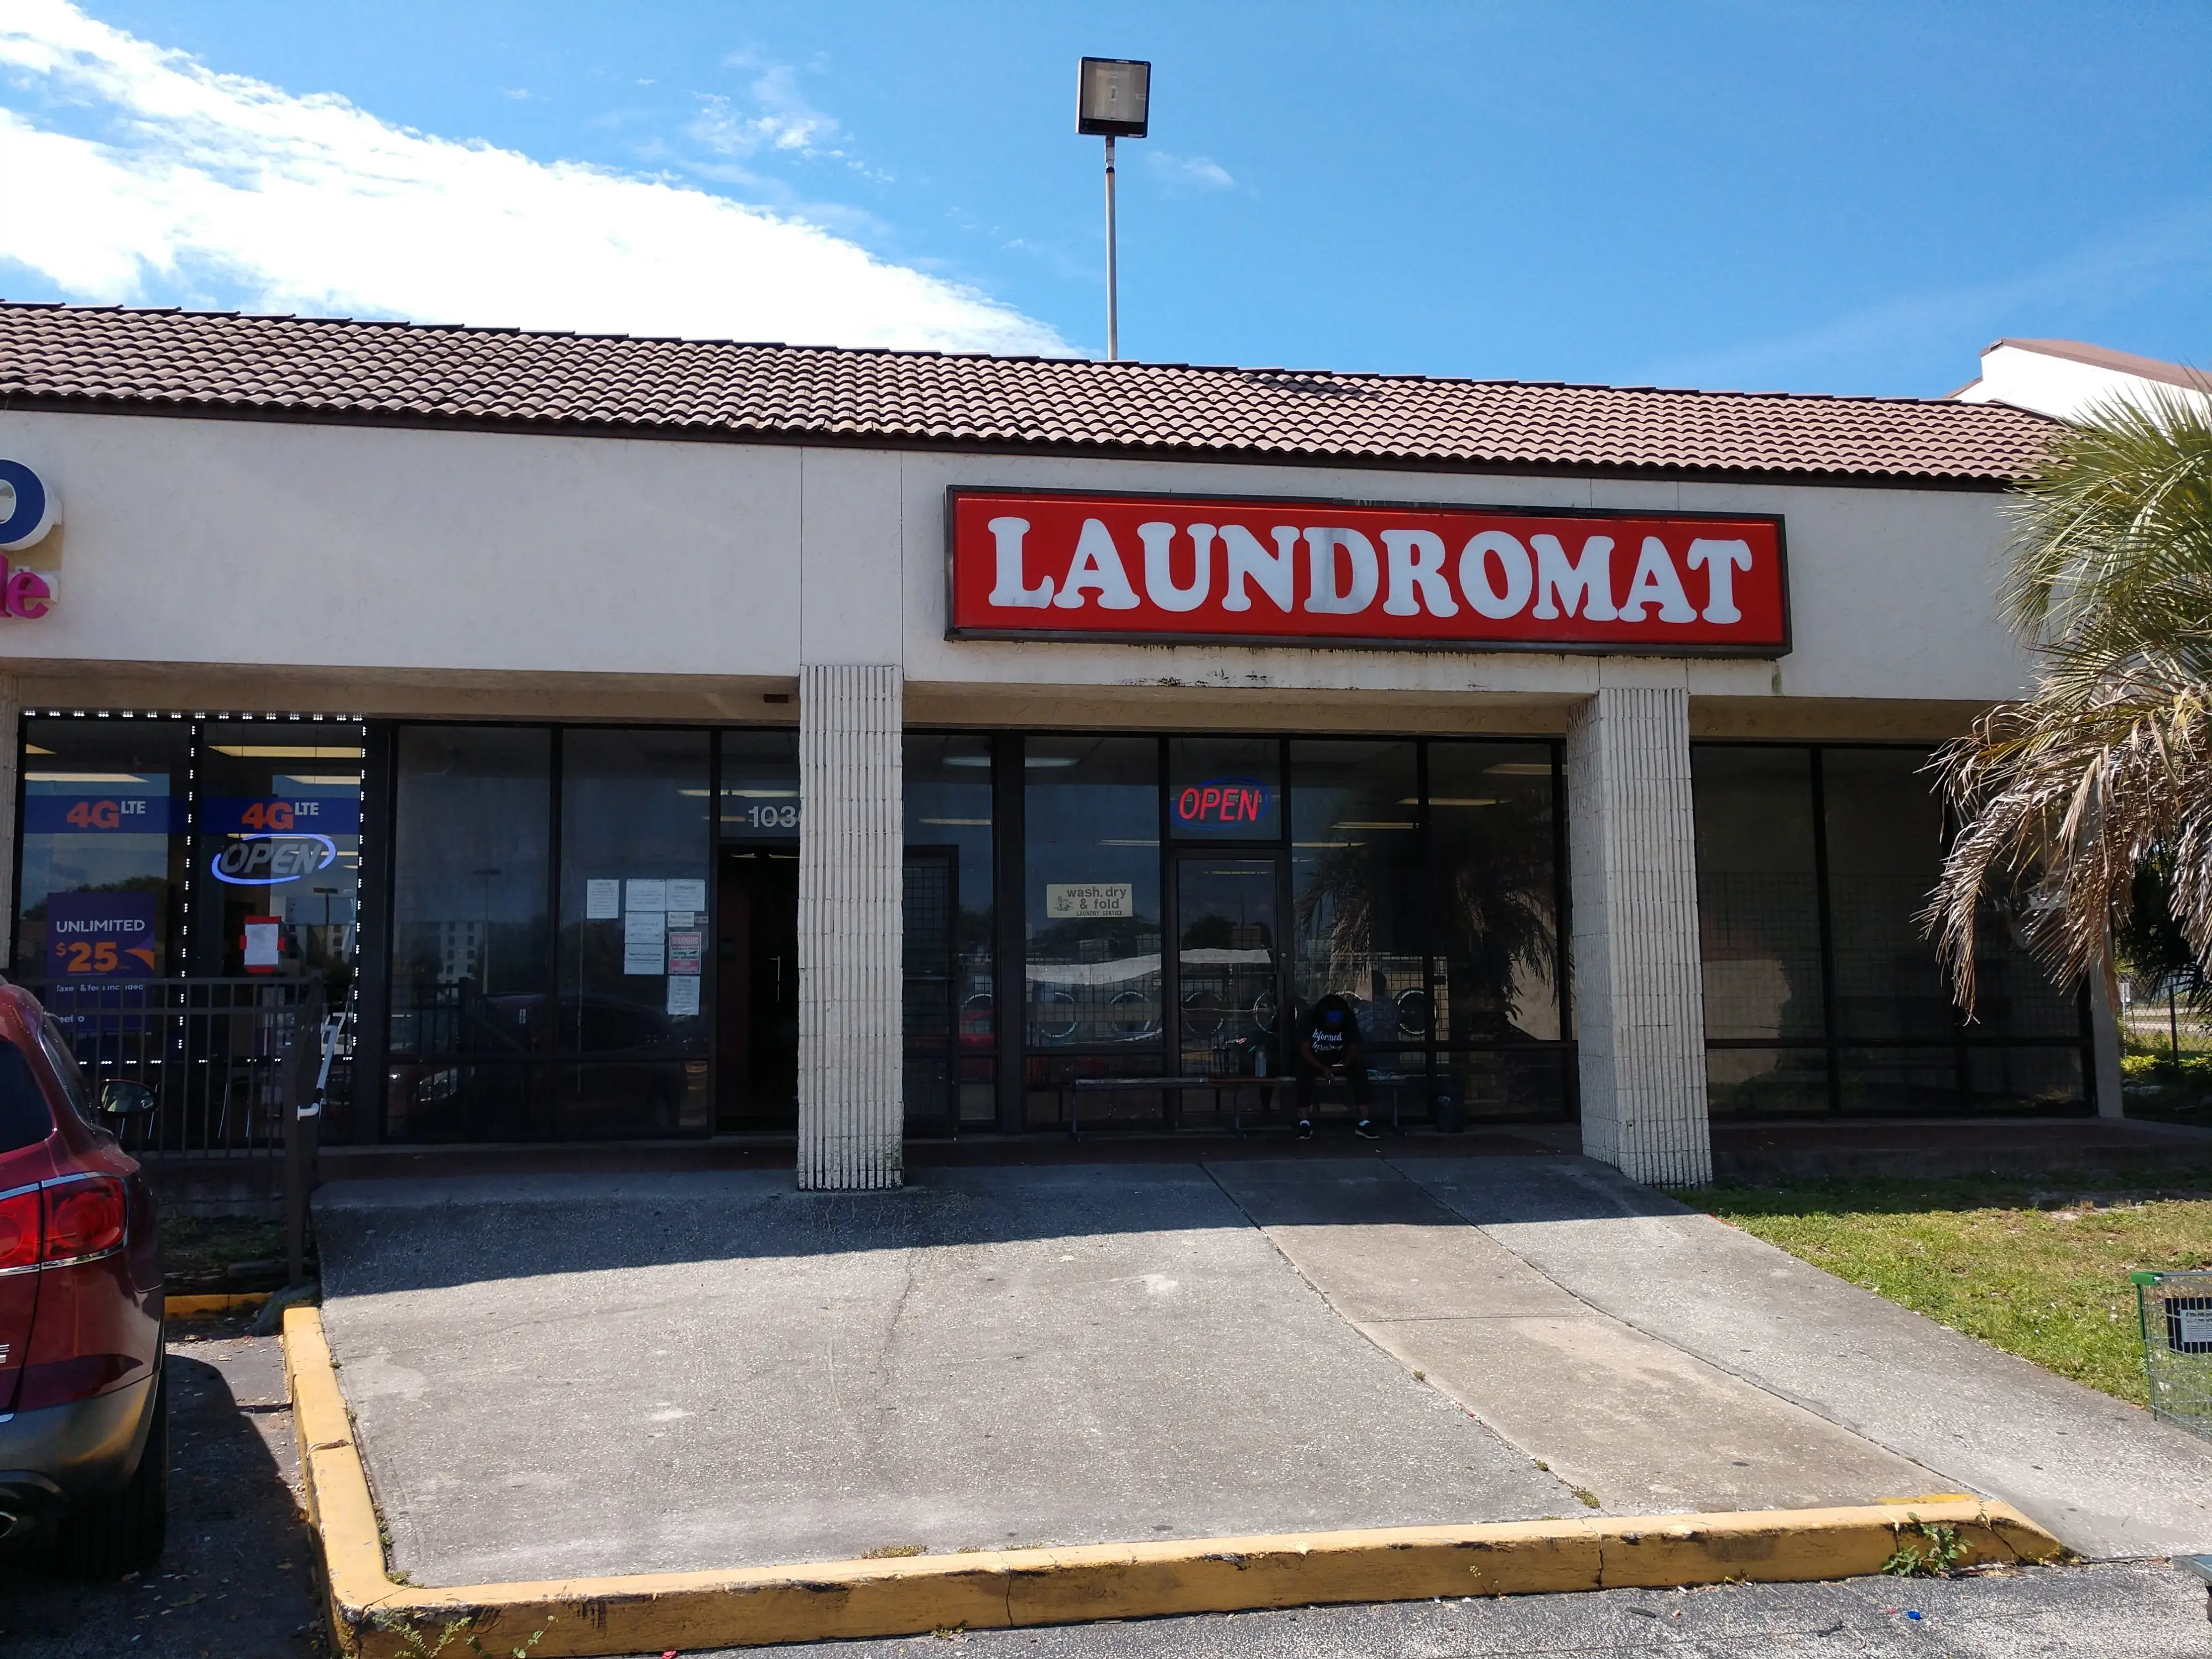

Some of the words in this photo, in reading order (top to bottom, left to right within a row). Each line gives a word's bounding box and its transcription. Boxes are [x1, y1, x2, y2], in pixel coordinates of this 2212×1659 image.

[988, 516, 1752, 624] LAUNDROMAT
[66, 801, 119, 828] 4G
[121, 800, 146, 815] LTE
[241, 802, 294, 830] 4G
[295, 802, 319, 816] LTE
[748, 805, 800, 828] 103
[1178, 787, 1260, 822] OPEN
[220, 843, 325, 875] OPEN
[1067, 886, 1103, 898] wash,
[1106, 886, 1126, 899] dry
[1079, 898, 1088, 910] &
[1093, 898, 1119, 909] fold
[56, 919, 145, 933] UNLIMITED
[56, 941, 118, 973] $25
